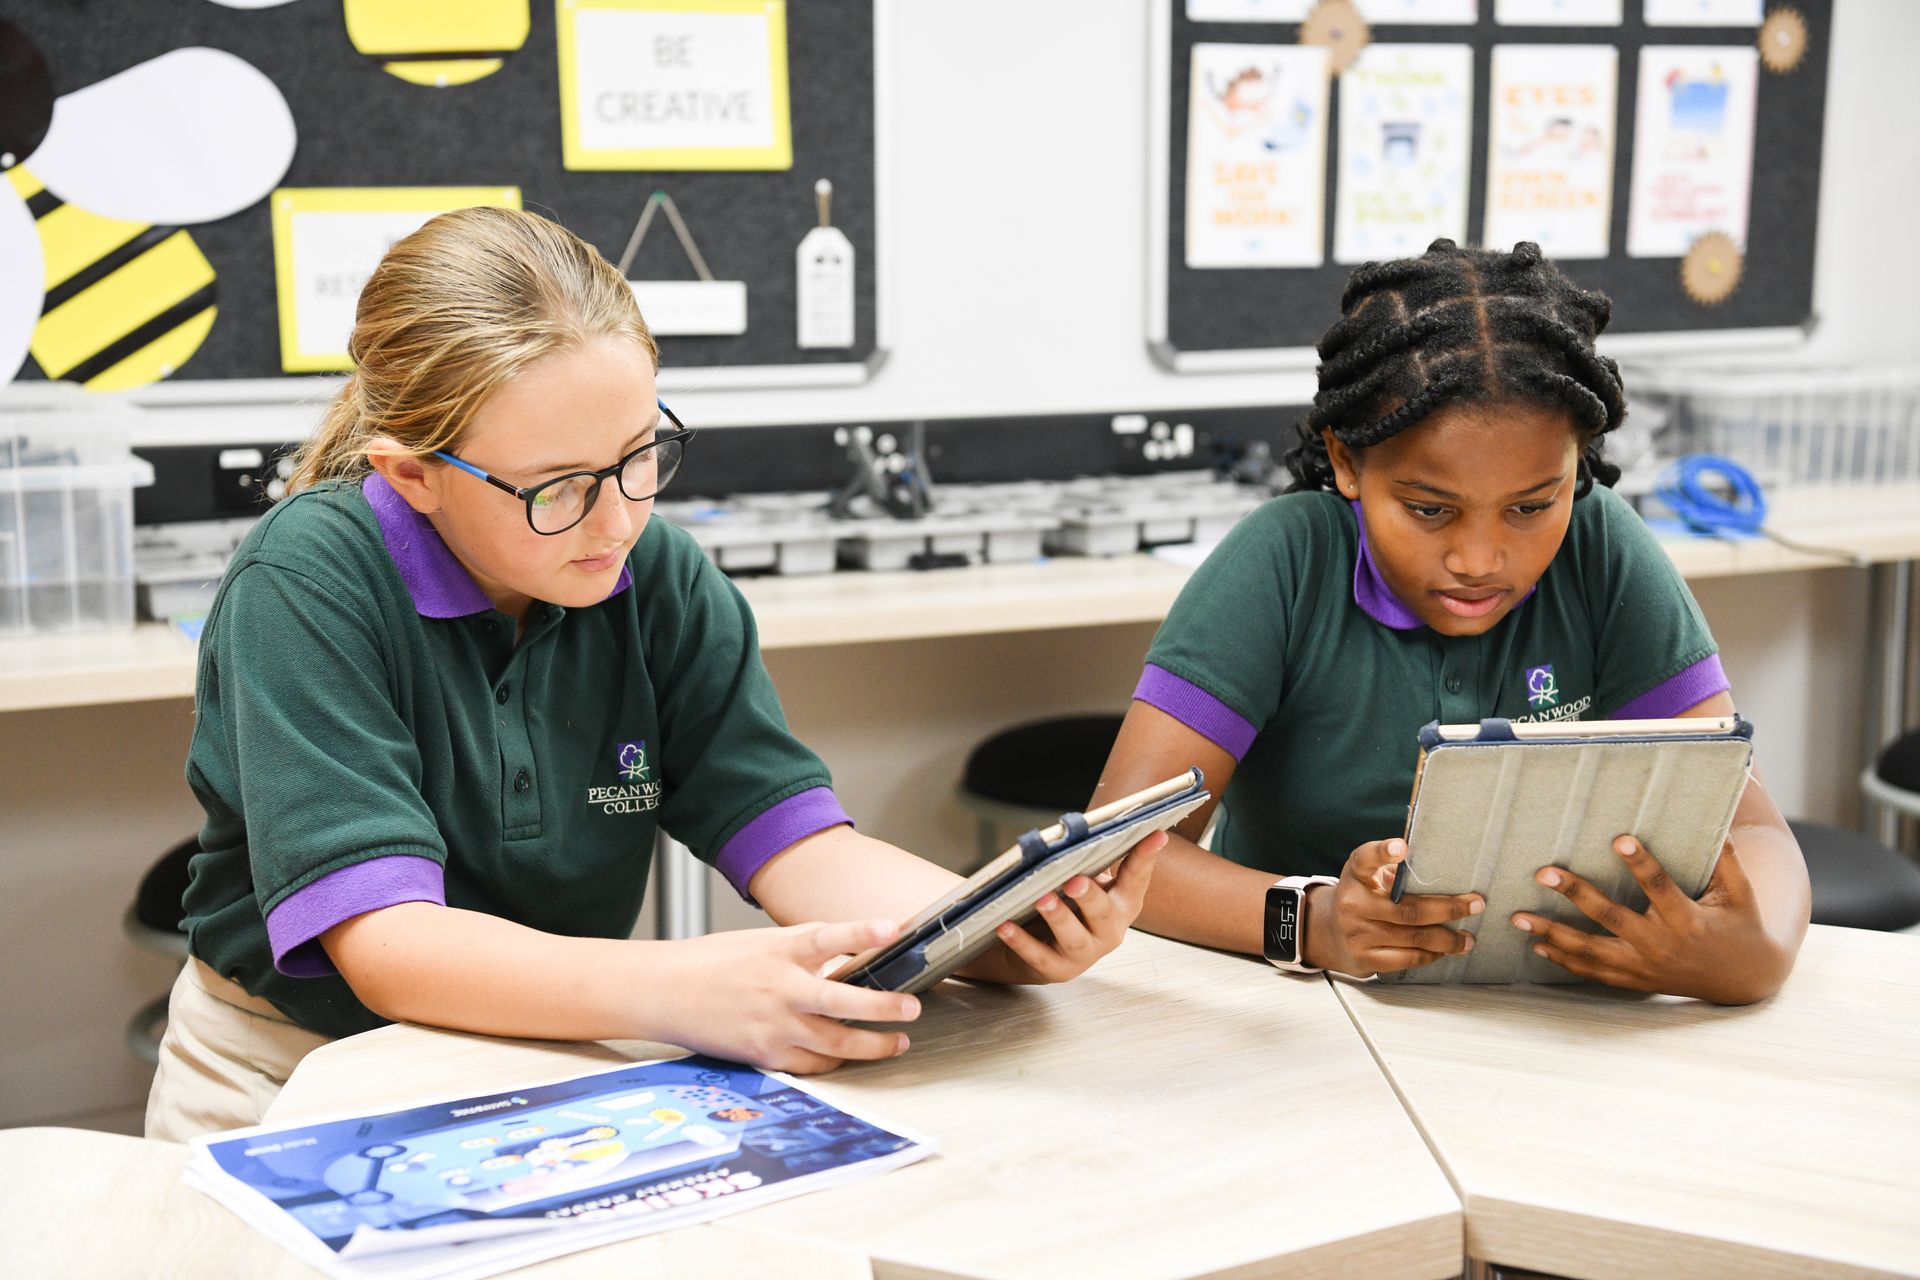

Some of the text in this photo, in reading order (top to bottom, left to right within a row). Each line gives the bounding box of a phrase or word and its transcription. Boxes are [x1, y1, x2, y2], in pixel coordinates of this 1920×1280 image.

[653, 33, 694, 68] BE
[595, 88, 759, 124] CREATIVE
[1504, 83, 1596, 106] EYES
[1509, 695, 1591, 723] CANWOOD
[587, 779, 662, 800] PECANWO
[603, 795, 661, 815] COLLE
